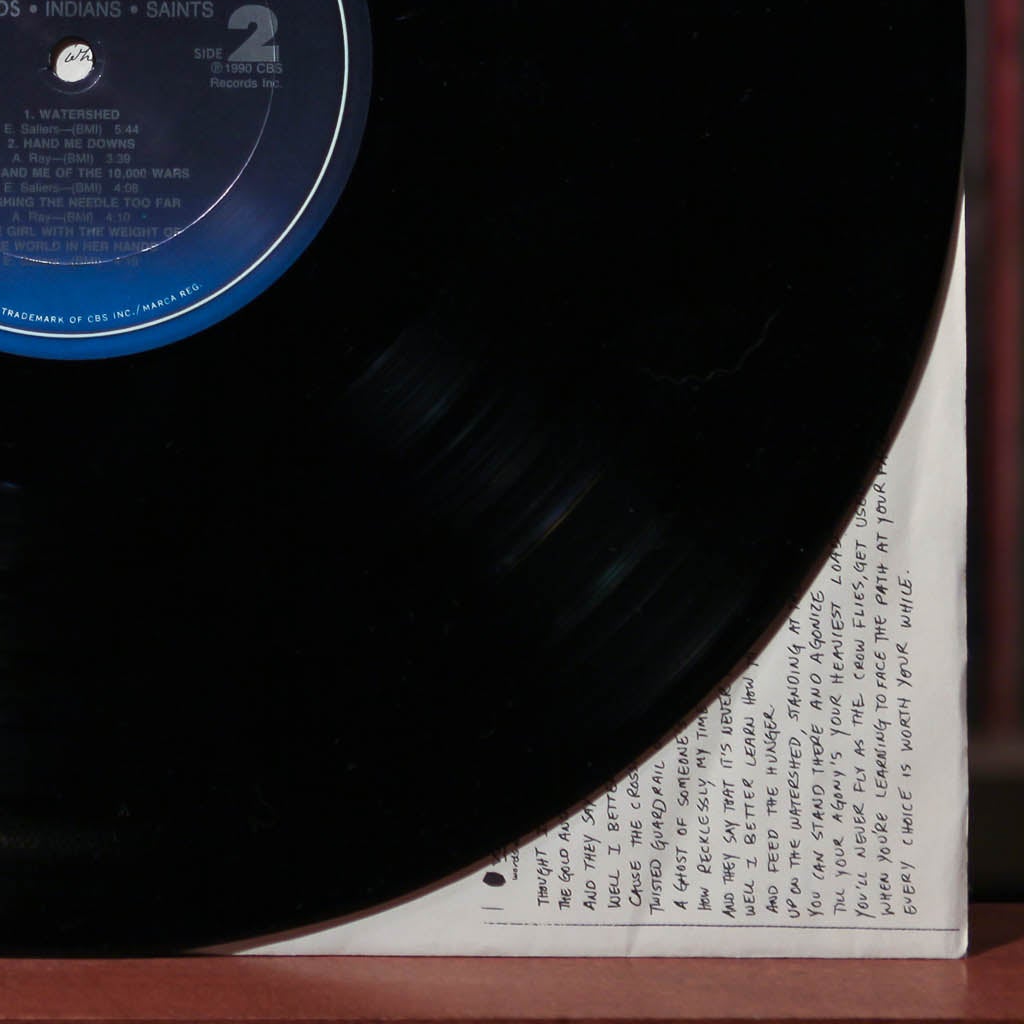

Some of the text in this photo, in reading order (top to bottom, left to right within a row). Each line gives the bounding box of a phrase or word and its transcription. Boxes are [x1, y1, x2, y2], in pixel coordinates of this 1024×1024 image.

[45, 0, 121, 18] INDIANS
[147, 1, 214, 18] SAINTS
[194, 4, 280, 62] SIDE 2
[210, 77, 258, 88] Records
[256, 64, 283, 74] CBS
[40, 110, 120, 120] WATERSHED
[24, 139, 60, 148] HAND
[64, 139, 82, 148] ME
[87, 139, 135, 148] DOWNS
[1, 168, 26, 178] AND
[32, 168, 50, 178] ME
[56, 168, 72, 178] OF
[79, 168, 102, 178] THE
[152, 168, 190, 178] WARS
[40, 198, 64, 208] THE
[69, 198, 118, 208] NEEDLE
[124, 198, 150, 208] TOO
[156, 198, 181, 208] FAR
[1, 307, 64, 324] TRADEMARK
[69, 316, 82, 324] OF
[87, 314, 108, 323] CBS
[896, 643, 912, 687] YOUR
[897, 698, 913, 751] WORTH
[807, 591, 826, 917] YOU CAN STAND THERE AND AGONIZE
[901, 764, 911, 777] IS
[766, 786, 779, 816] THE
[898, 787, 913, 845] CHOICE
[649, 761, 669, 915] TWISTED GUARDRAIL
[768, 829, 779, 873] FEED
[766, 885, 778, 914] AND
[900, 861, 917, 915] EVERY
